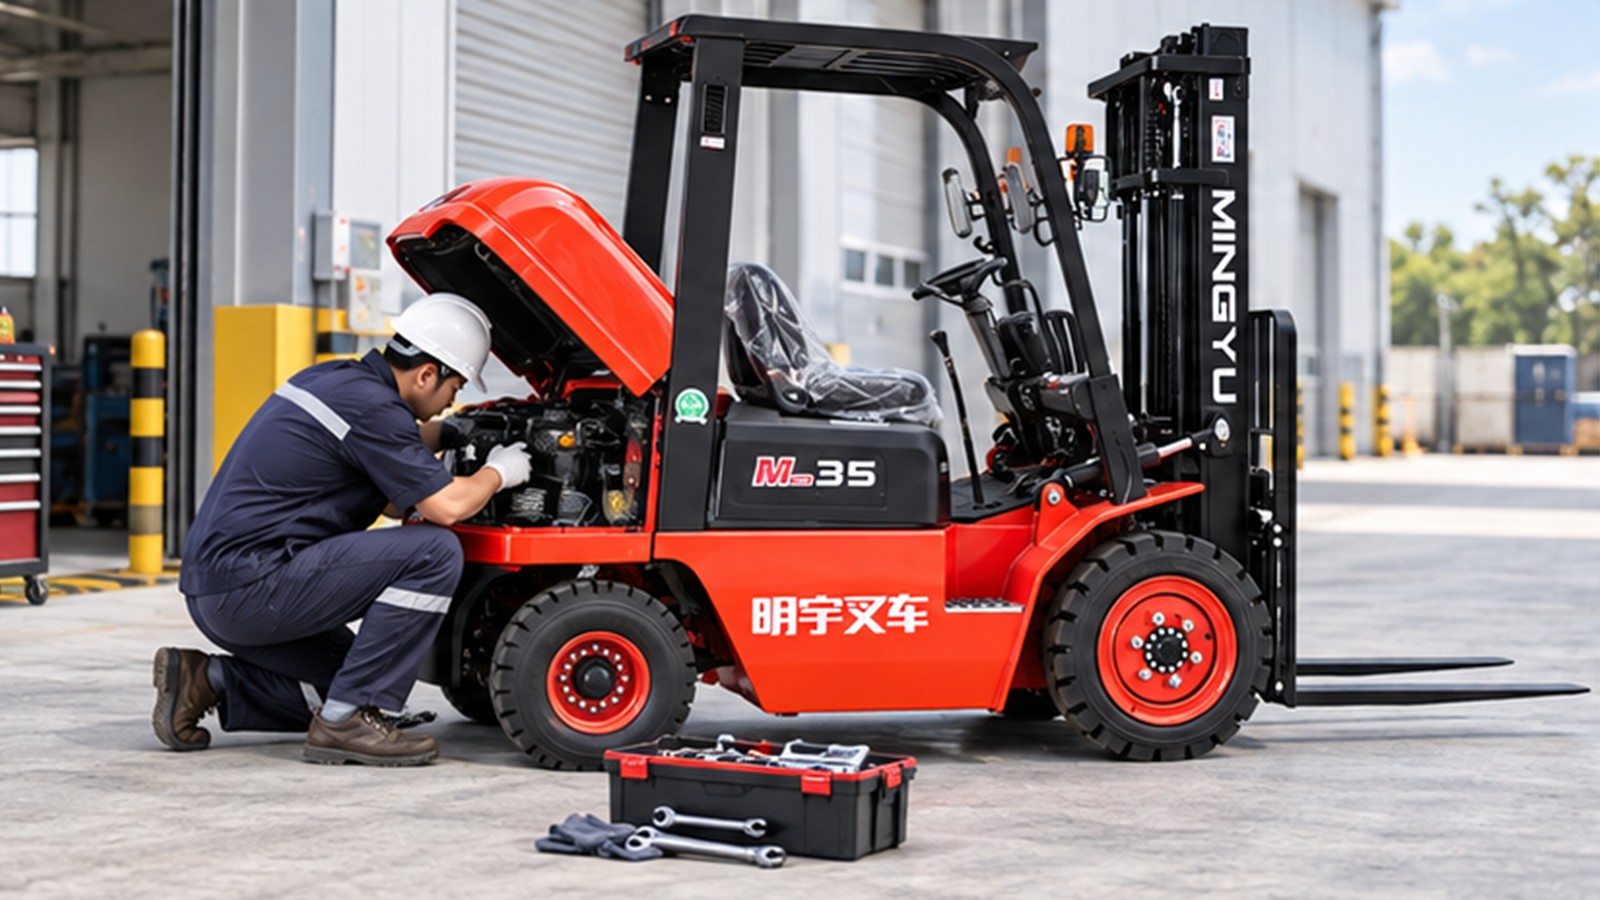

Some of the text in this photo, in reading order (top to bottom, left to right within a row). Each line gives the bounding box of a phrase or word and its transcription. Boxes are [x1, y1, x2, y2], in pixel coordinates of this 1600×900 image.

[1212, 189, 1237, 404] MINGYU
[815, 460, 876, 487] 35
[751, 593, 929, 636] 明宇叉车
